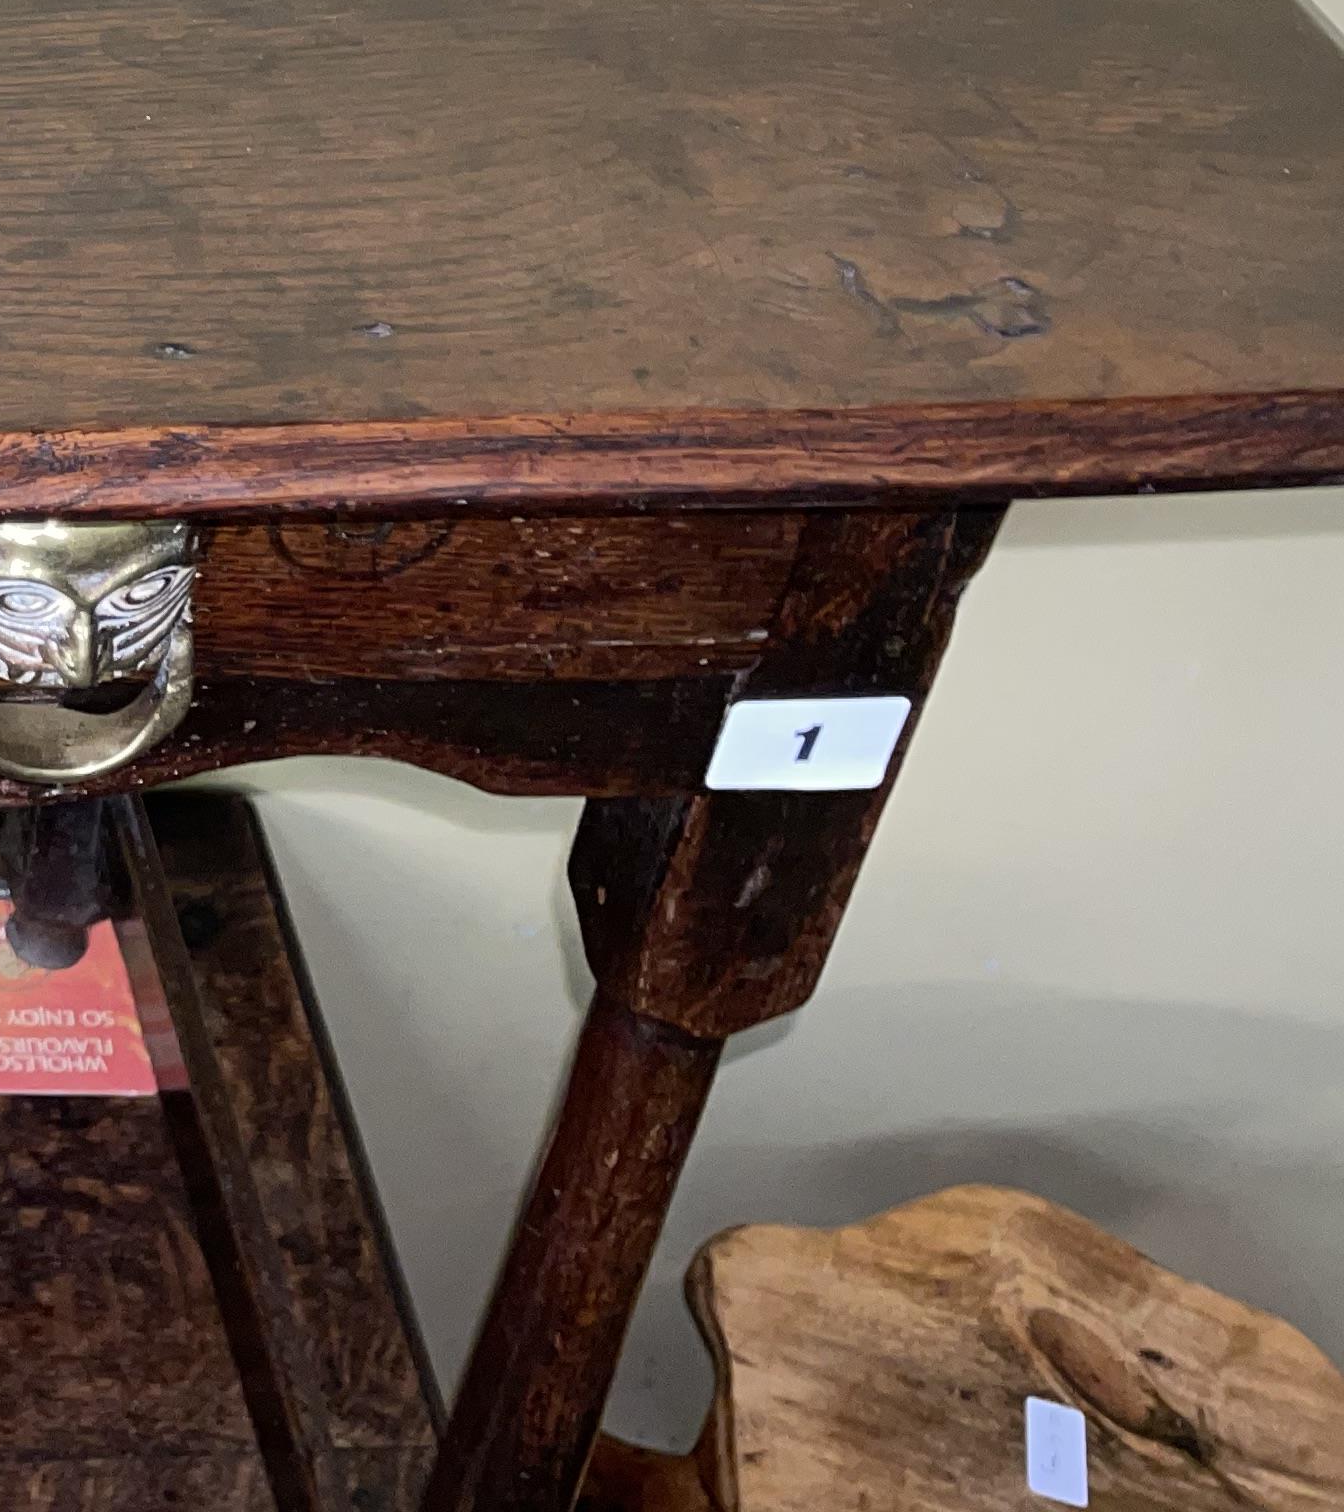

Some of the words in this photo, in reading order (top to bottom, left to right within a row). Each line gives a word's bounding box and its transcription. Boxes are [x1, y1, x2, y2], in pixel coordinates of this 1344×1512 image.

[795, 724, 824, 763] 1
[8, 1007, 75, 1027] ENJOY
[82, 1010, 115, 1027] SO
